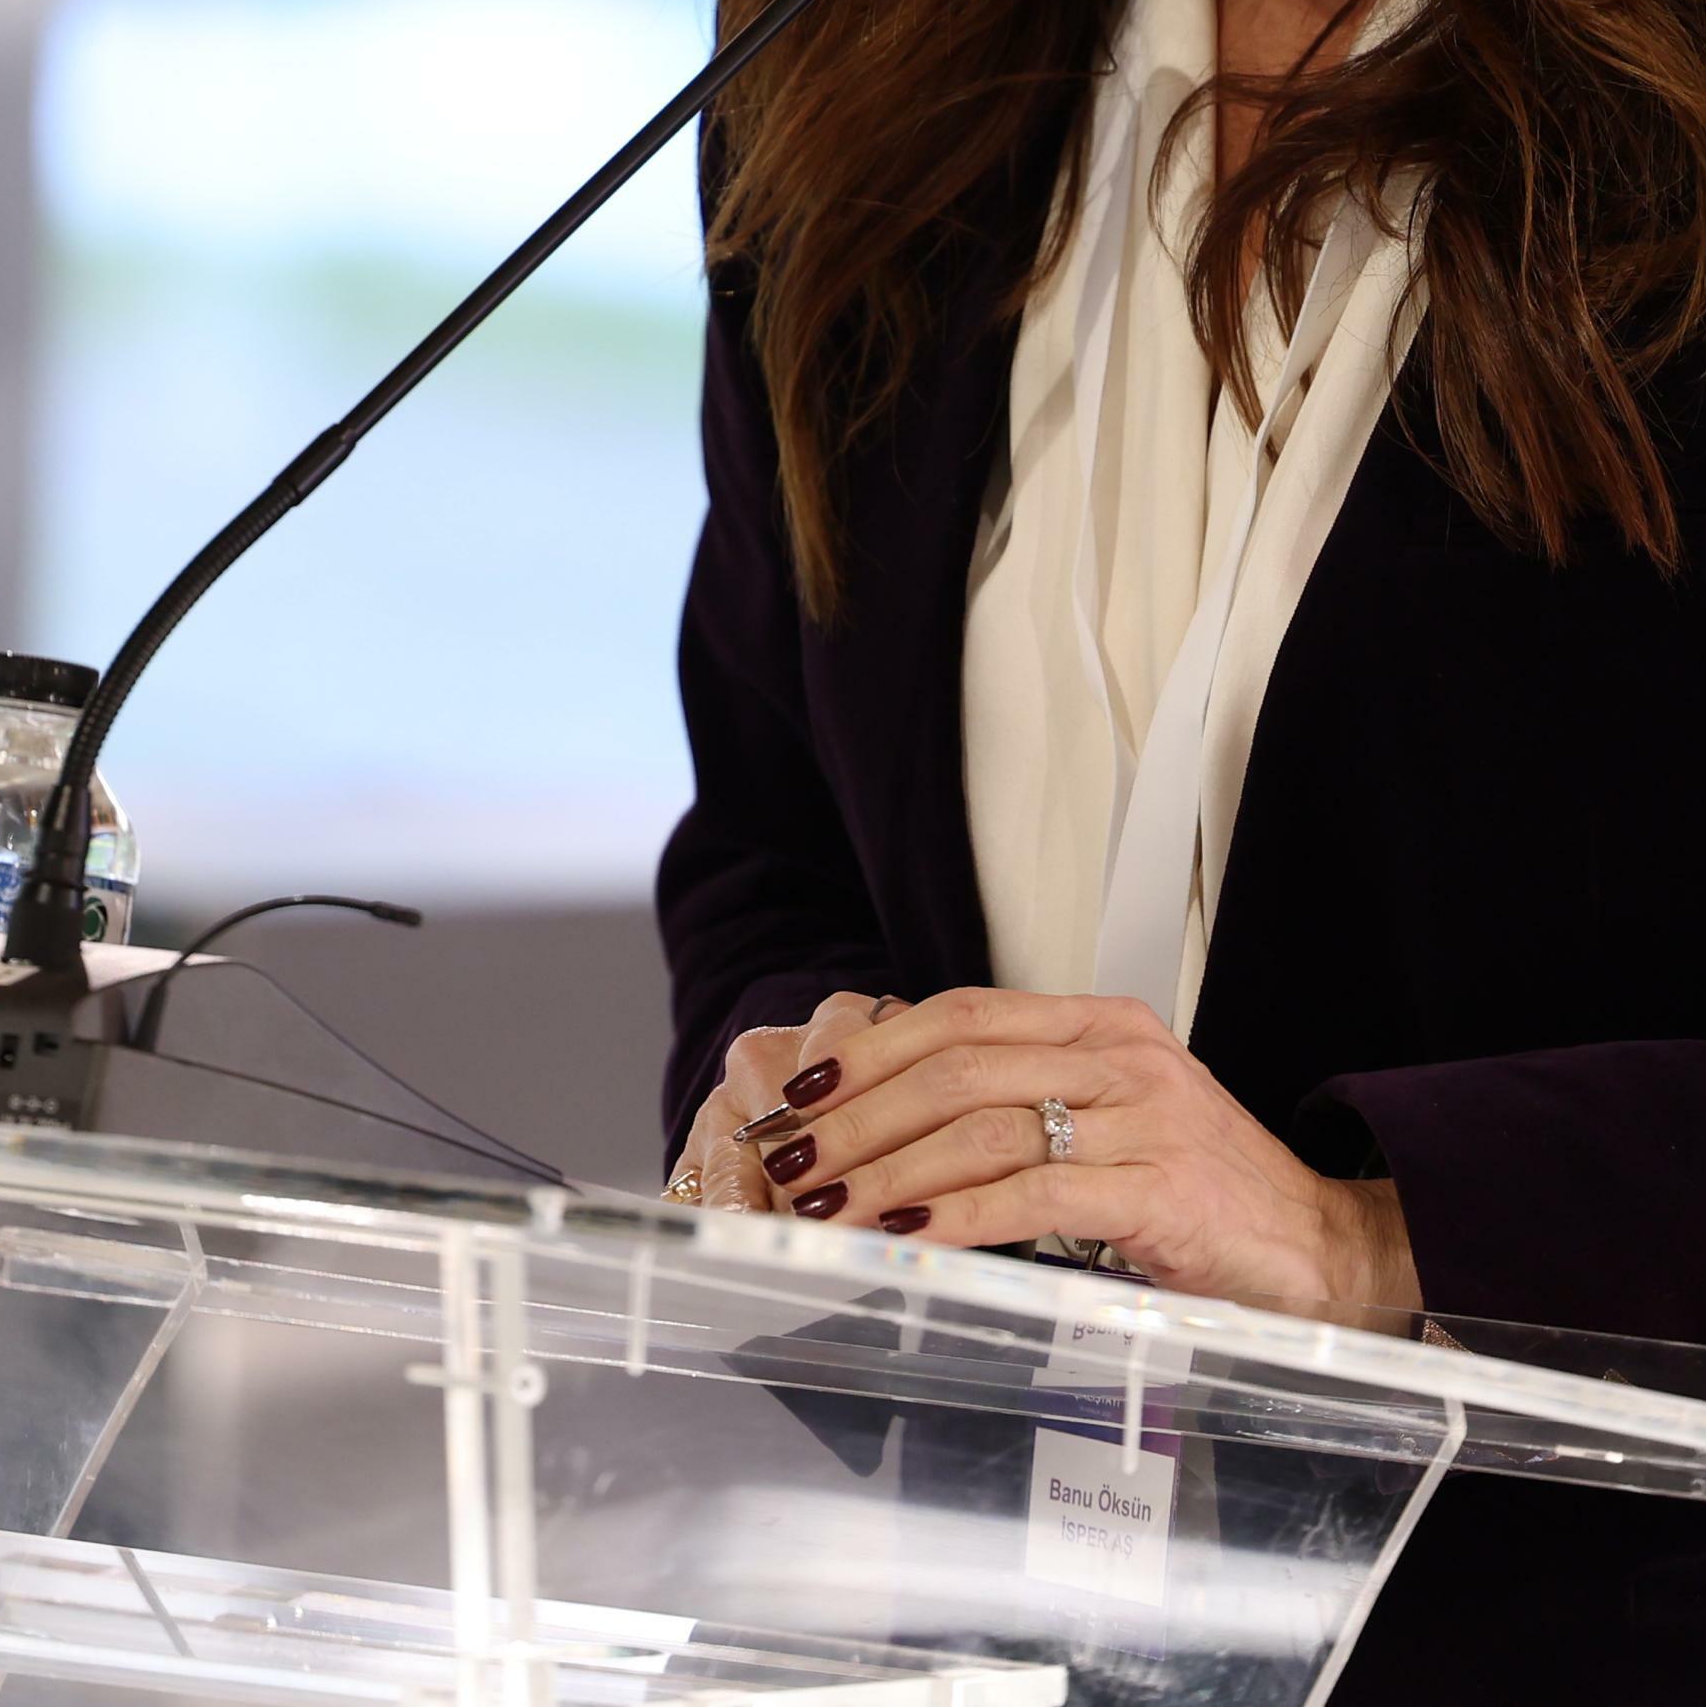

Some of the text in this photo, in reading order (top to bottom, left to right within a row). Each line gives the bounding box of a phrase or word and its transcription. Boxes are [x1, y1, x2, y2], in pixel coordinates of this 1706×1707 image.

[1049, 1477, 1152, 1522] Banu Öksün
[1061, 1514, 1109, 1551] İSPER
